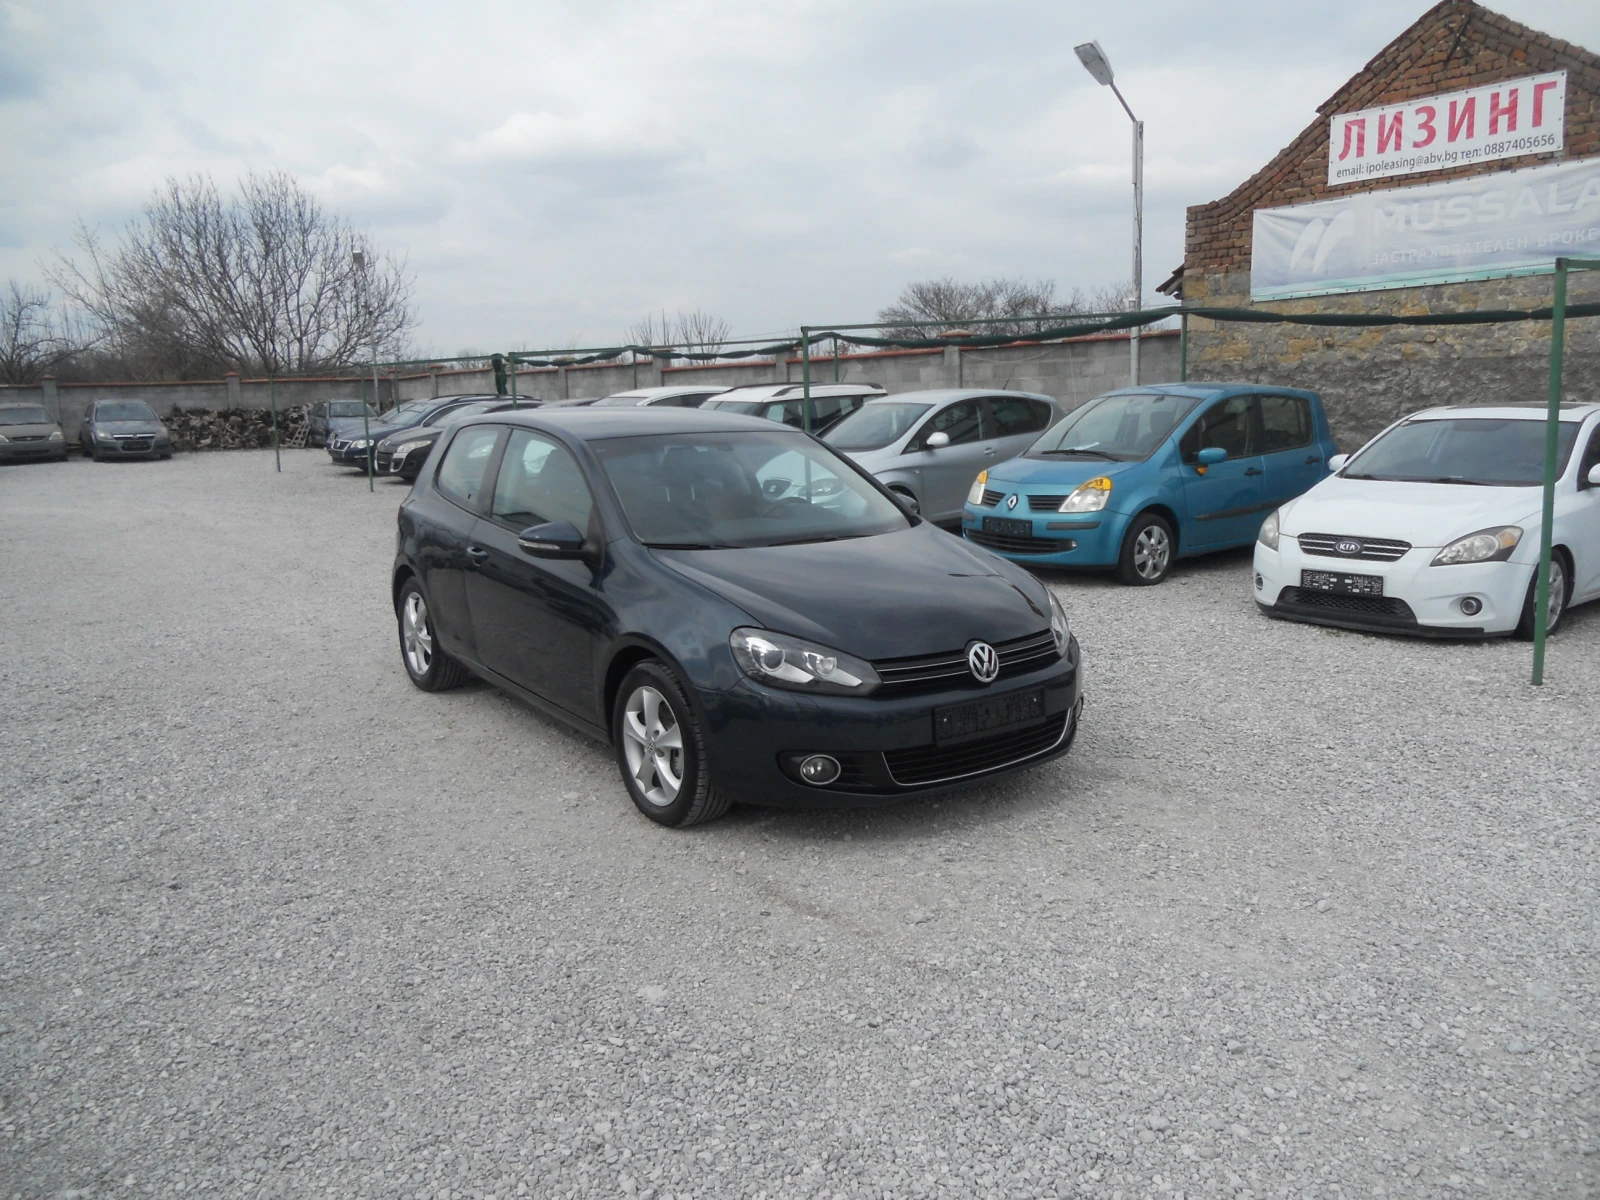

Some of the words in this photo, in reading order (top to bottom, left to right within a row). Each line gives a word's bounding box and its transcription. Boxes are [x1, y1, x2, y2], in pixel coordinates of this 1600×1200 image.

[1338, 81, 1557, 161] ЛИЗИНГ
[1336, 164, 1365, 178] email:
[1365, 150, 1458, 175] ipoleasing@abv.bg
[1460, 148, 1482, 160] тел:
[1484, 134, 1555, 156] 0887405656
[1373, 177, 1600, 235] MUSSALA
[1340, 543, 1355, 551] KIA
